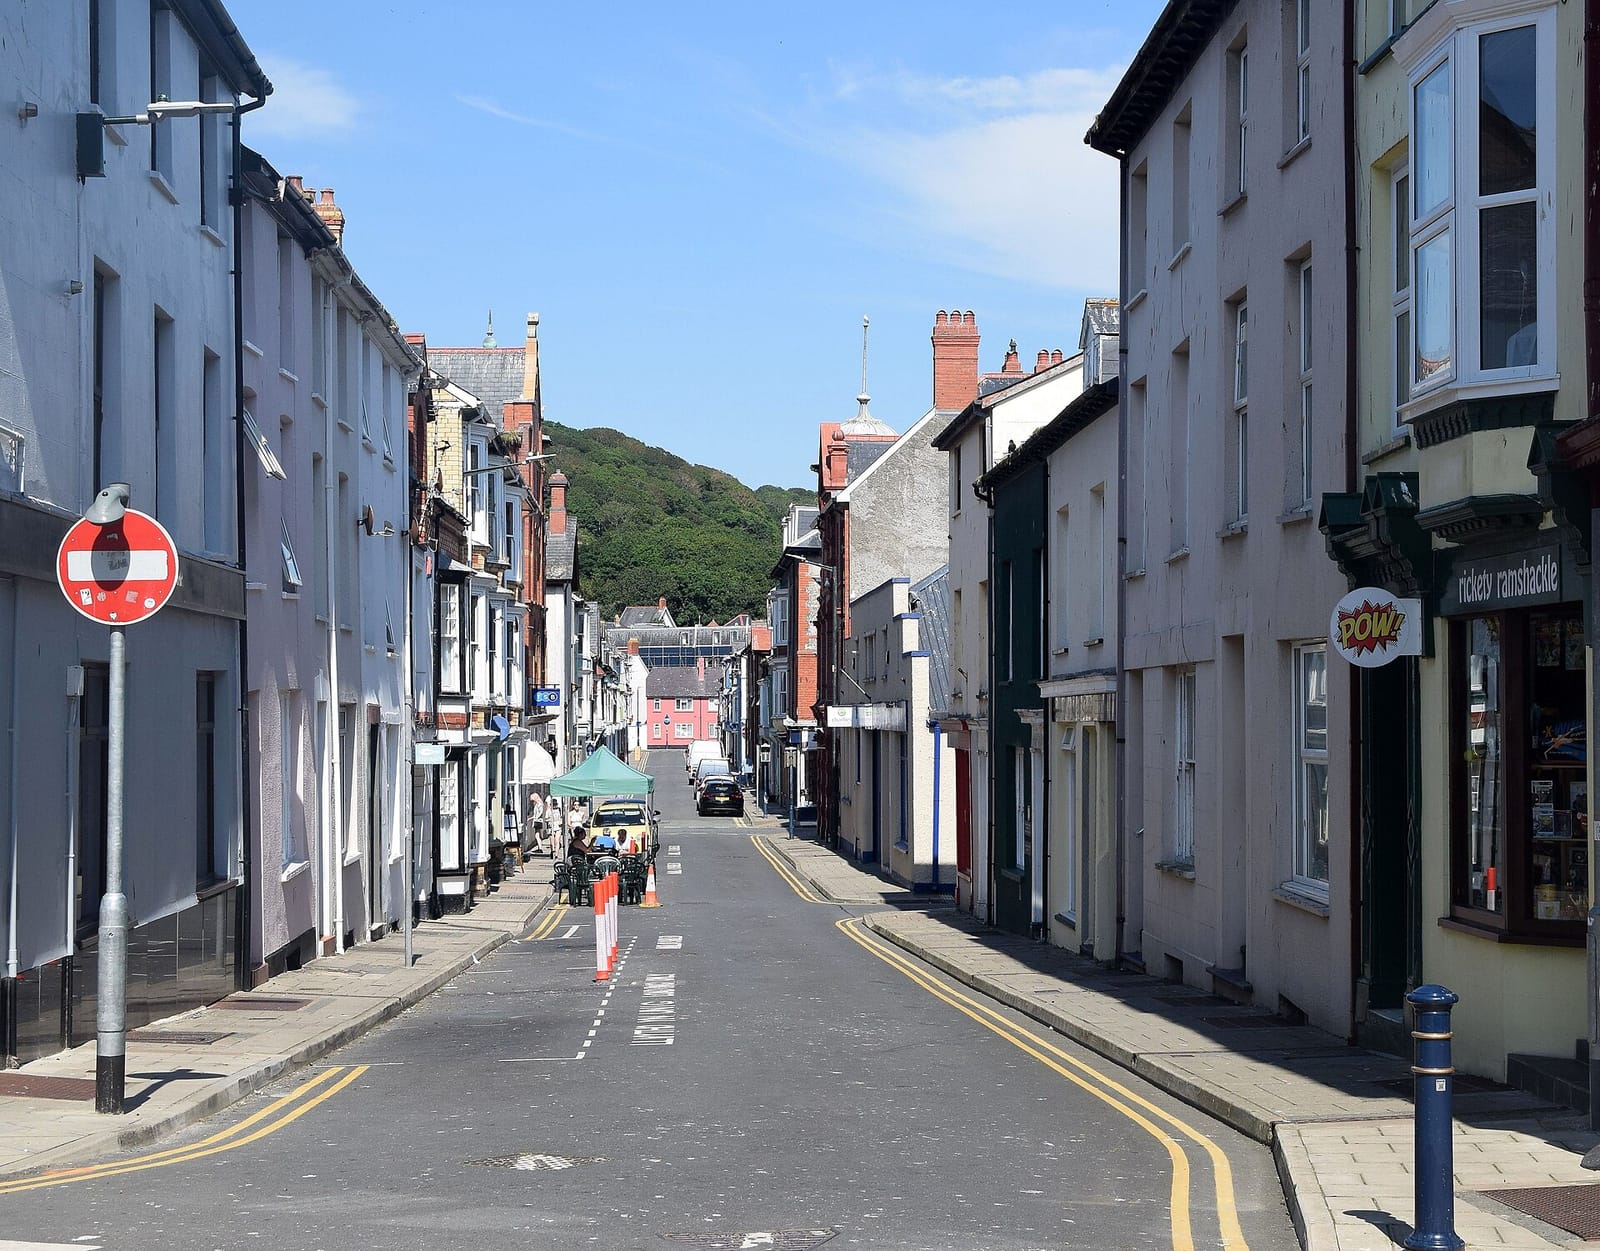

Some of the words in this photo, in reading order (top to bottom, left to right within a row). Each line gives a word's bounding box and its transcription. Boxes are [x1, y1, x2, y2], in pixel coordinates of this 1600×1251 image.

[1459, 568, 1492, 603] rickety
[1497, 554, 1558, 599] ramshackle
[1340, 611, 1404, 649] POW!
